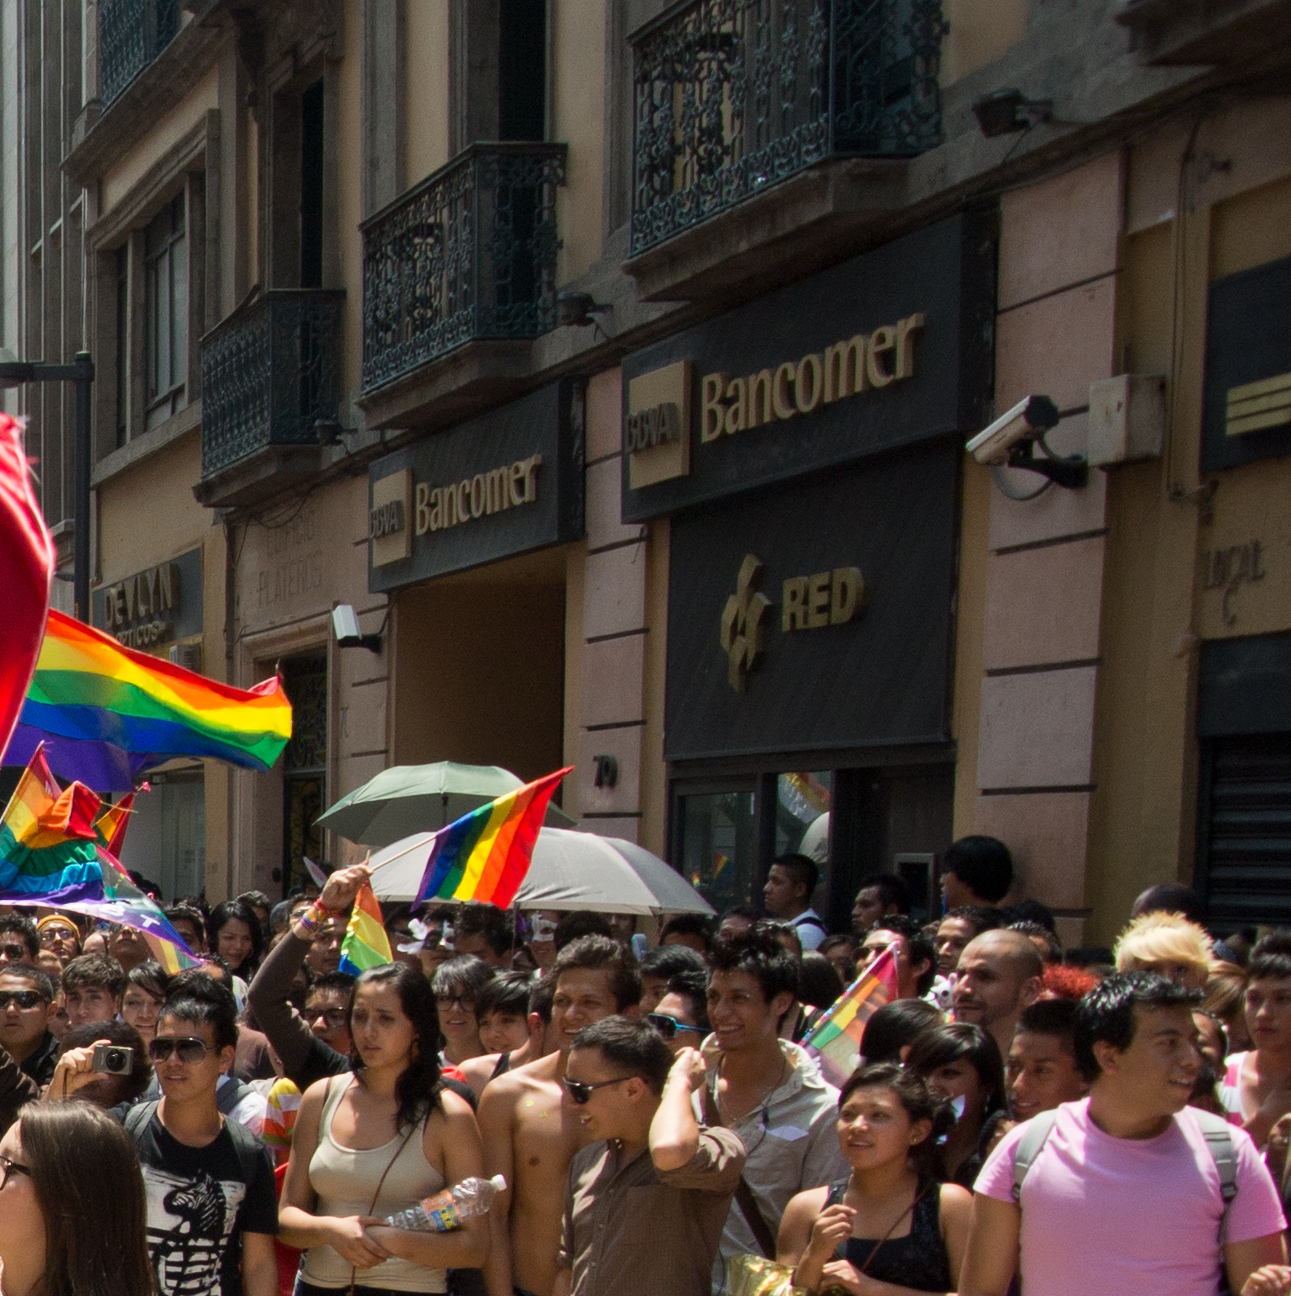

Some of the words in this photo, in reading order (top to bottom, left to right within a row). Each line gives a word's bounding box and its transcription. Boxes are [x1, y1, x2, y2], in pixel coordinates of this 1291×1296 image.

[701, 312, 925, 443] Bancomer
[415, 454, 541, 536] Bancomer
[104, 562, 181, 630] DEVLYN
[782, 566, 865, 632] RED
